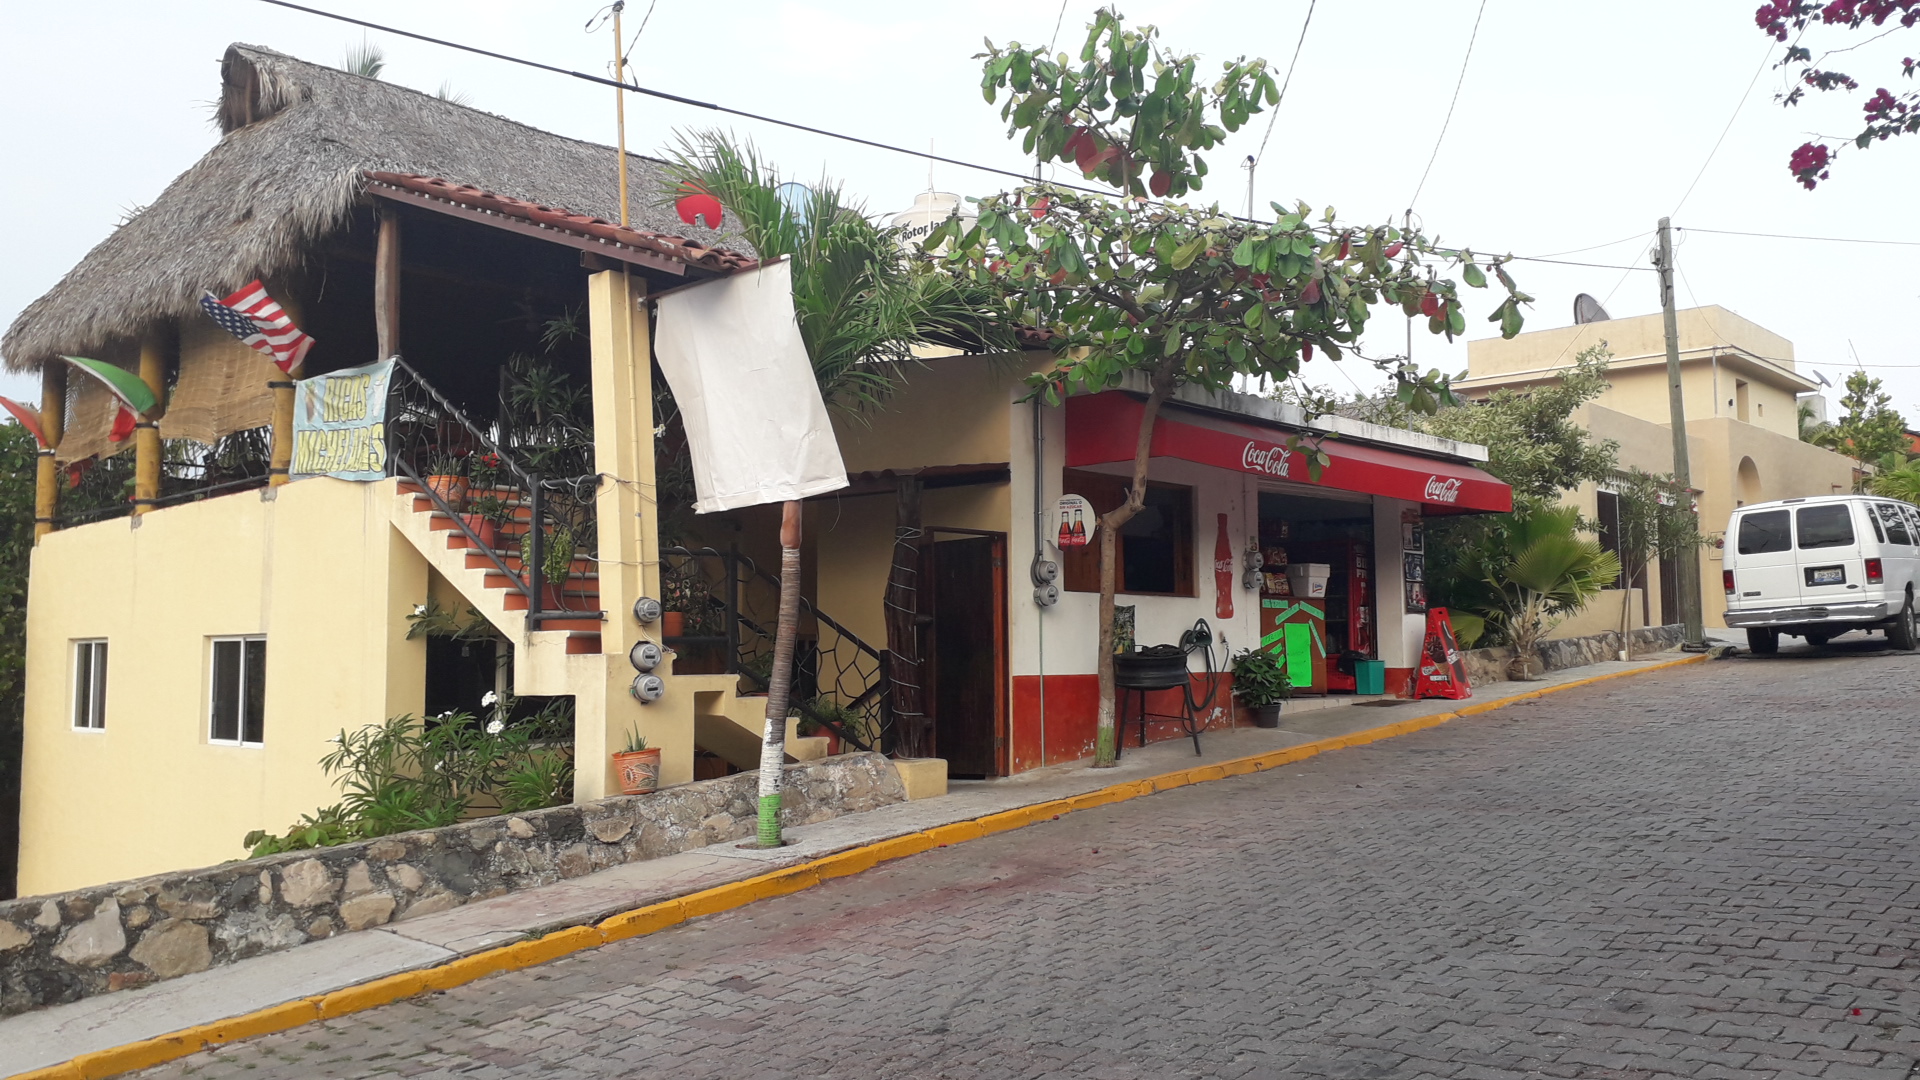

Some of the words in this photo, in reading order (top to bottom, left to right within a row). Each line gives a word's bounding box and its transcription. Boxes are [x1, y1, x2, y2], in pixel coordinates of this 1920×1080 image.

[323, 373, 371, 422] RICAS
[1242, 441, 1291, 478] Coca-Cola
[1424, 475, 1462, 503] Coca-Cola
